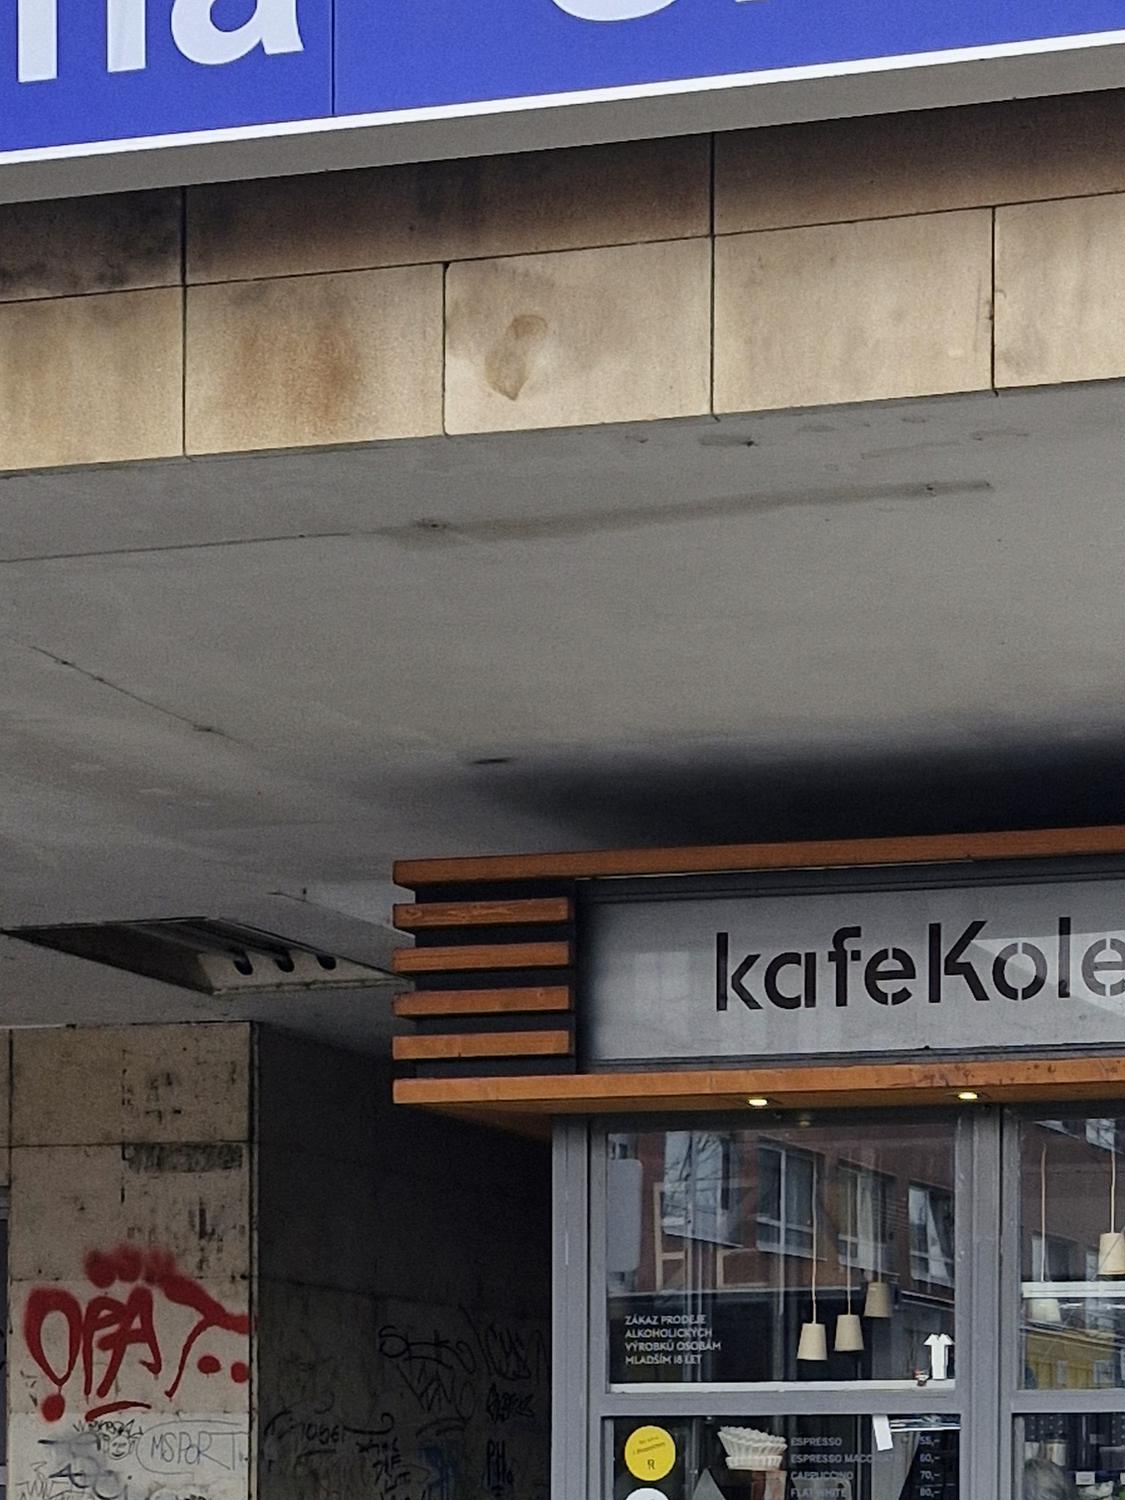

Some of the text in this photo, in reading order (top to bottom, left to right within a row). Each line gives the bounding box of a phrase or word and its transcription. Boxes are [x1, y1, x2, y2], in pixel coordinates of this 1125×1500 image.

[625, 1314, 706, 1325] ZÁKAZ PRODEJE
[625, 1327, 712, 1338] ALKOHOLICKÝCH
[625, 1340, 721, 1351] VÝROBKŮ OSOBÁM
[625, 1353, 671, 1365] MLADŠÍM
[685, 1354, 702, 1364] LET
[790, 1437, 842, 1446] ESPRESSO
[790, 1454, 842, 1463] ESPRESSO
[790, 1471, 854, 1480] CAPPUCCINO
